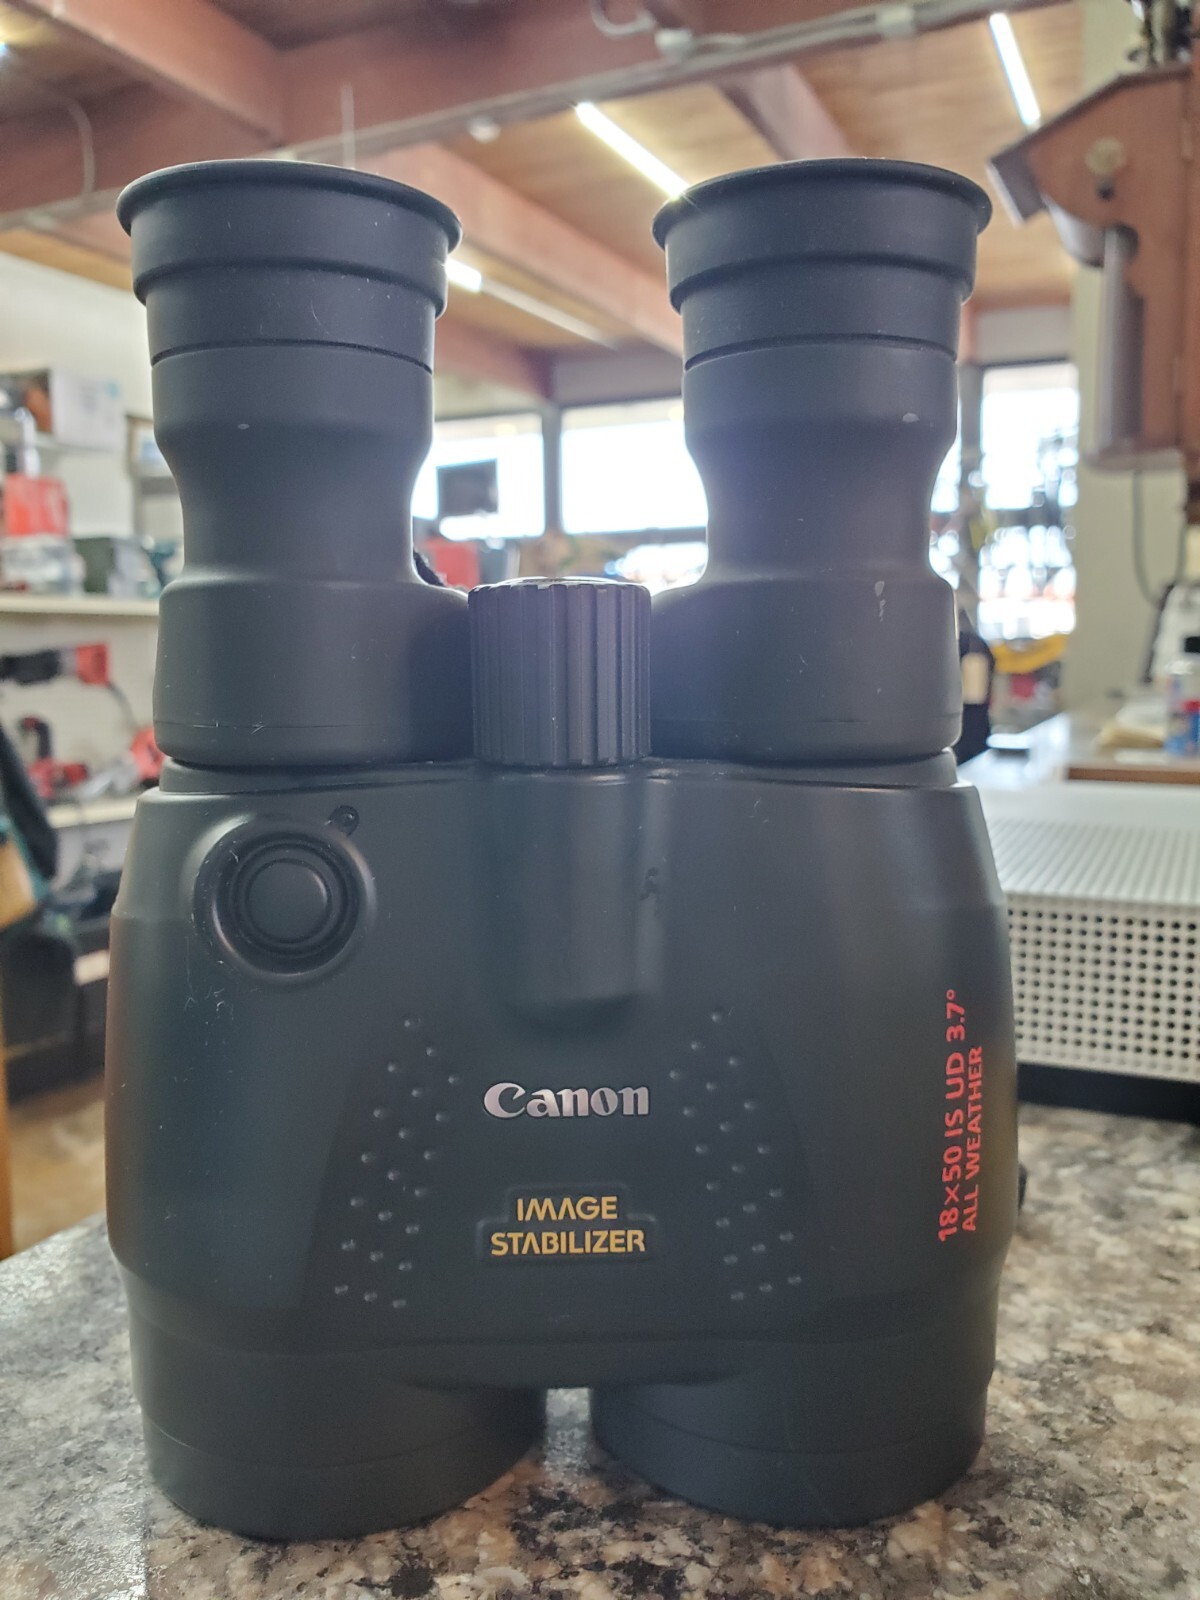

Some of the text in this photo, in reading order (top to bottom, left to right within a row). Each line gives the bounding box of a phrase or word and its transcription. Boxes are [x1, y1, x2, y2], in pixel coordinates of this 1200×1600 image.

[945, 1051, 965, 1100] UD
[483, 1082, 649, 1119] Canon
[944, 1108, 964, 1138] IS
[961, 1046, 983, 1232] ALL WEATHER
[516, 1195, 618, 1222] IMAGE
[490, 1229, 646, 1256] STABILIZER
